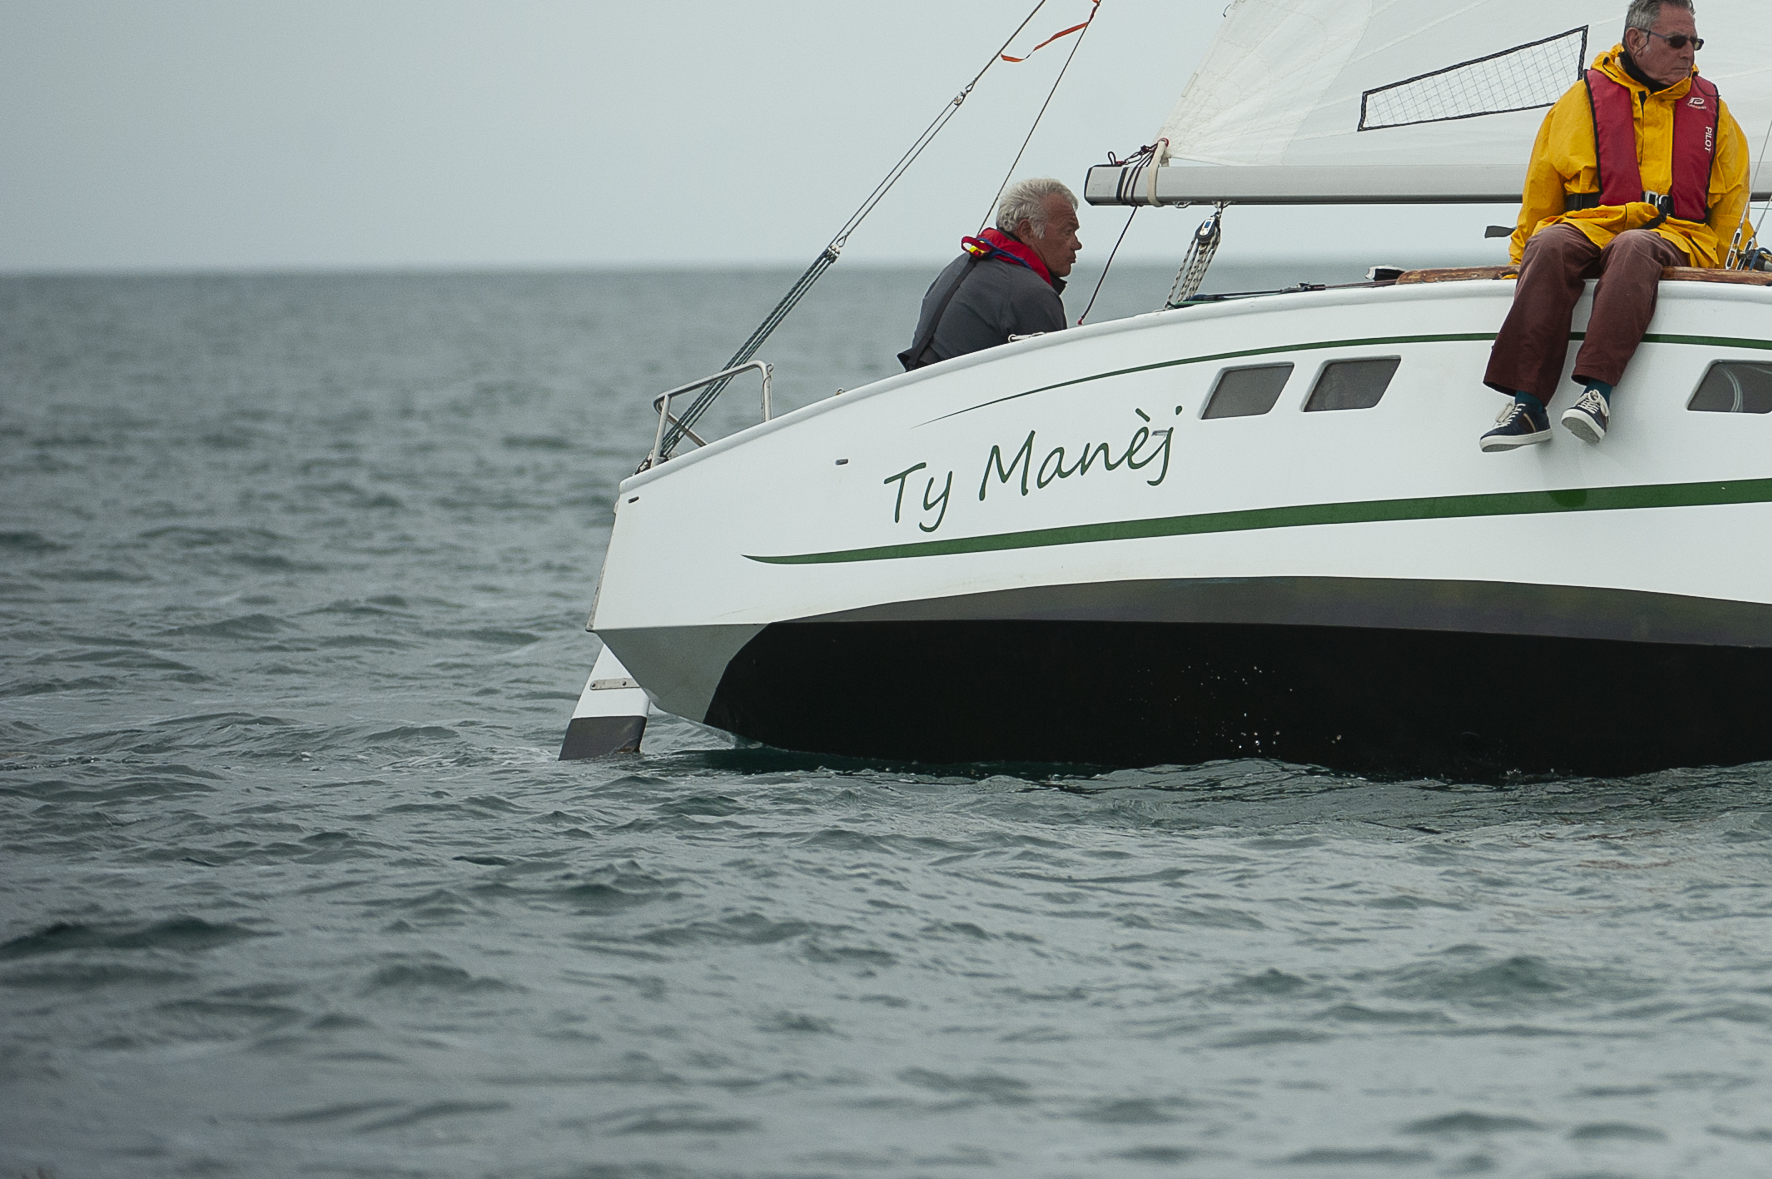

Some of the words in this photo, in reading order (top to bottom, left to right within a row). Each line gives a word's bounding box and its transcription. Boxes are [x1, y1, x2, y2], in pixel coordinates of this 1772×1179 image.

[1704, 126, 1713, 154] PILOT
[883, 462, 953, 533] Ty
[979, 405, 1183, 502] Manèj
